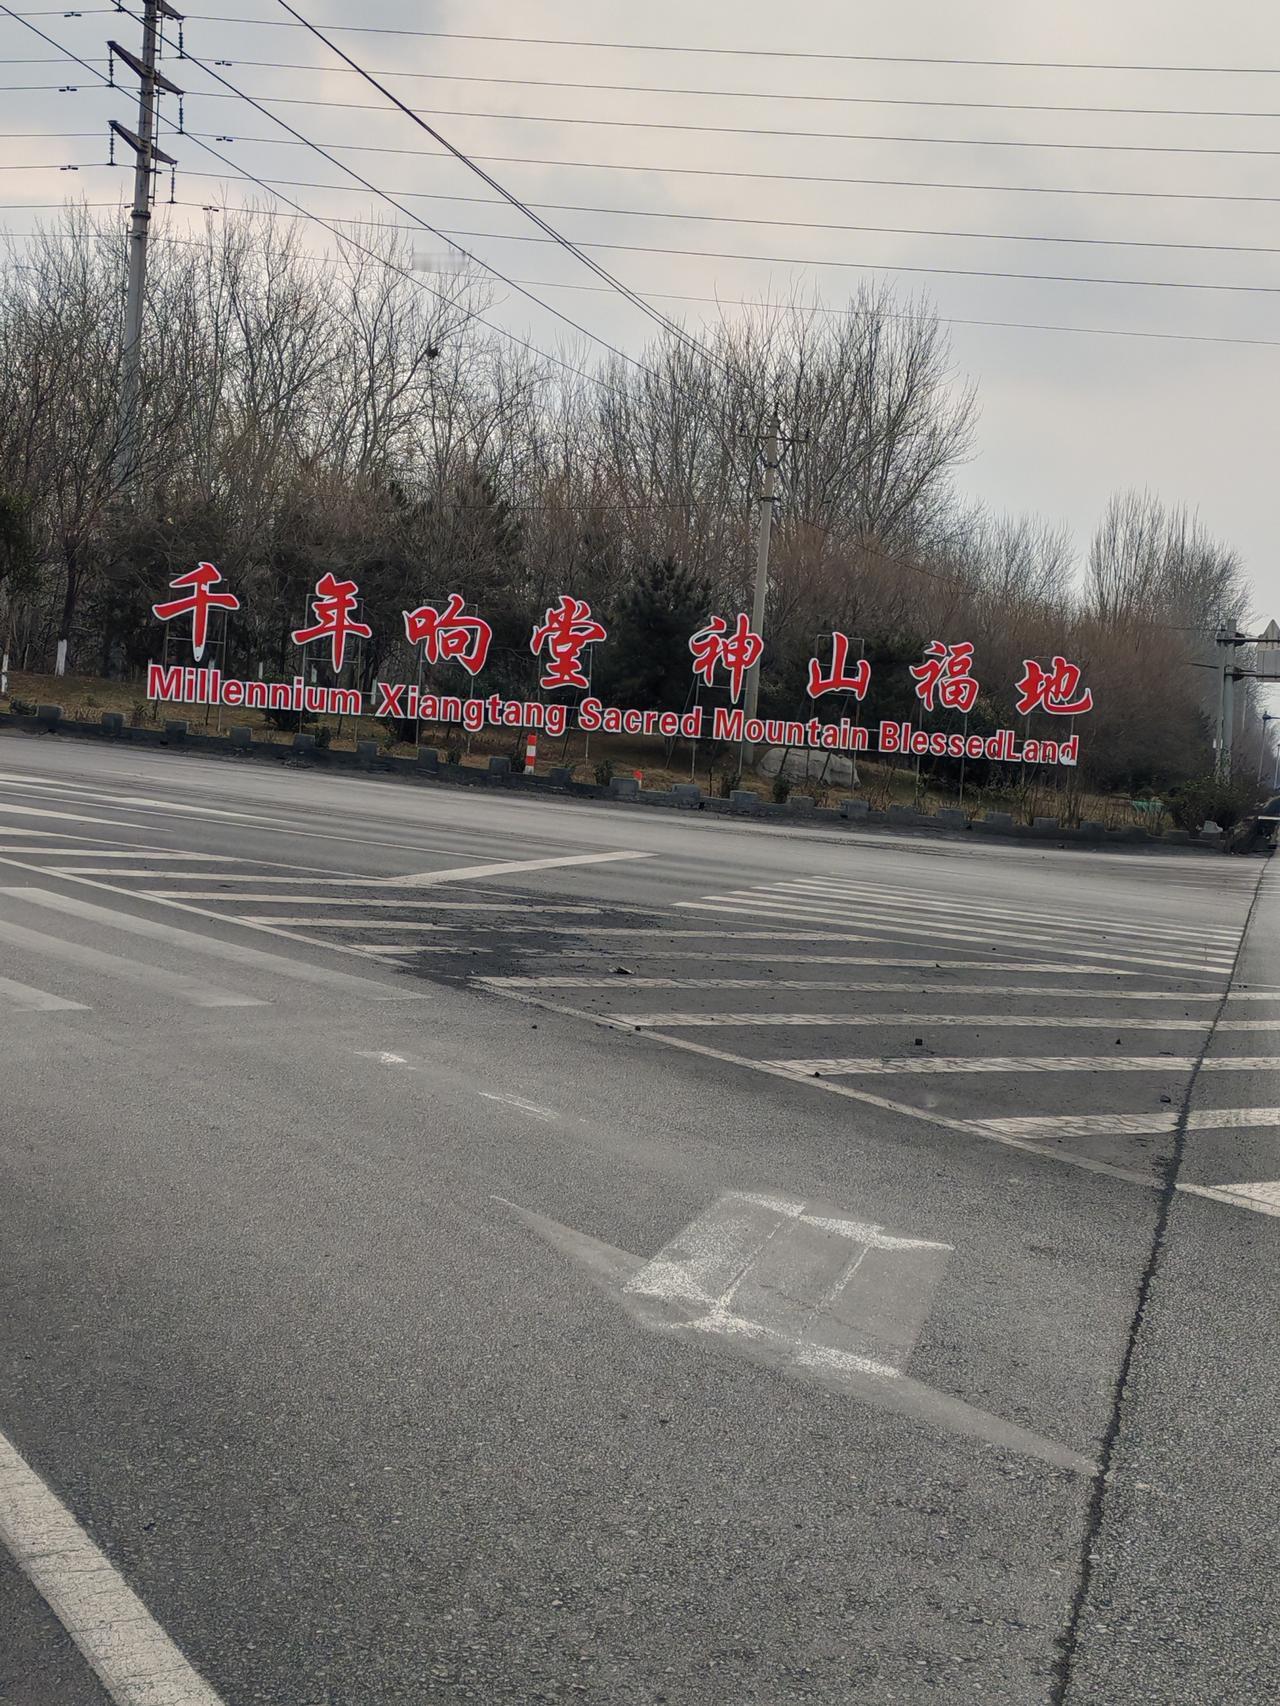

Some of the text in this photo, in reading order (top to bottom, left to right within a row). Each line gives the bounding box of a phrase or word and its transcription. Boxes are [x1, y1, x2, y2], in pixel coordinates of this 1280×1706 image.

[146, 664, 363, 716] Millennium
[377, 682, 568, 737] Xiangtang
[577, 697, 702, 739] Sacred
[713, 709, 869, 750] Mountain
